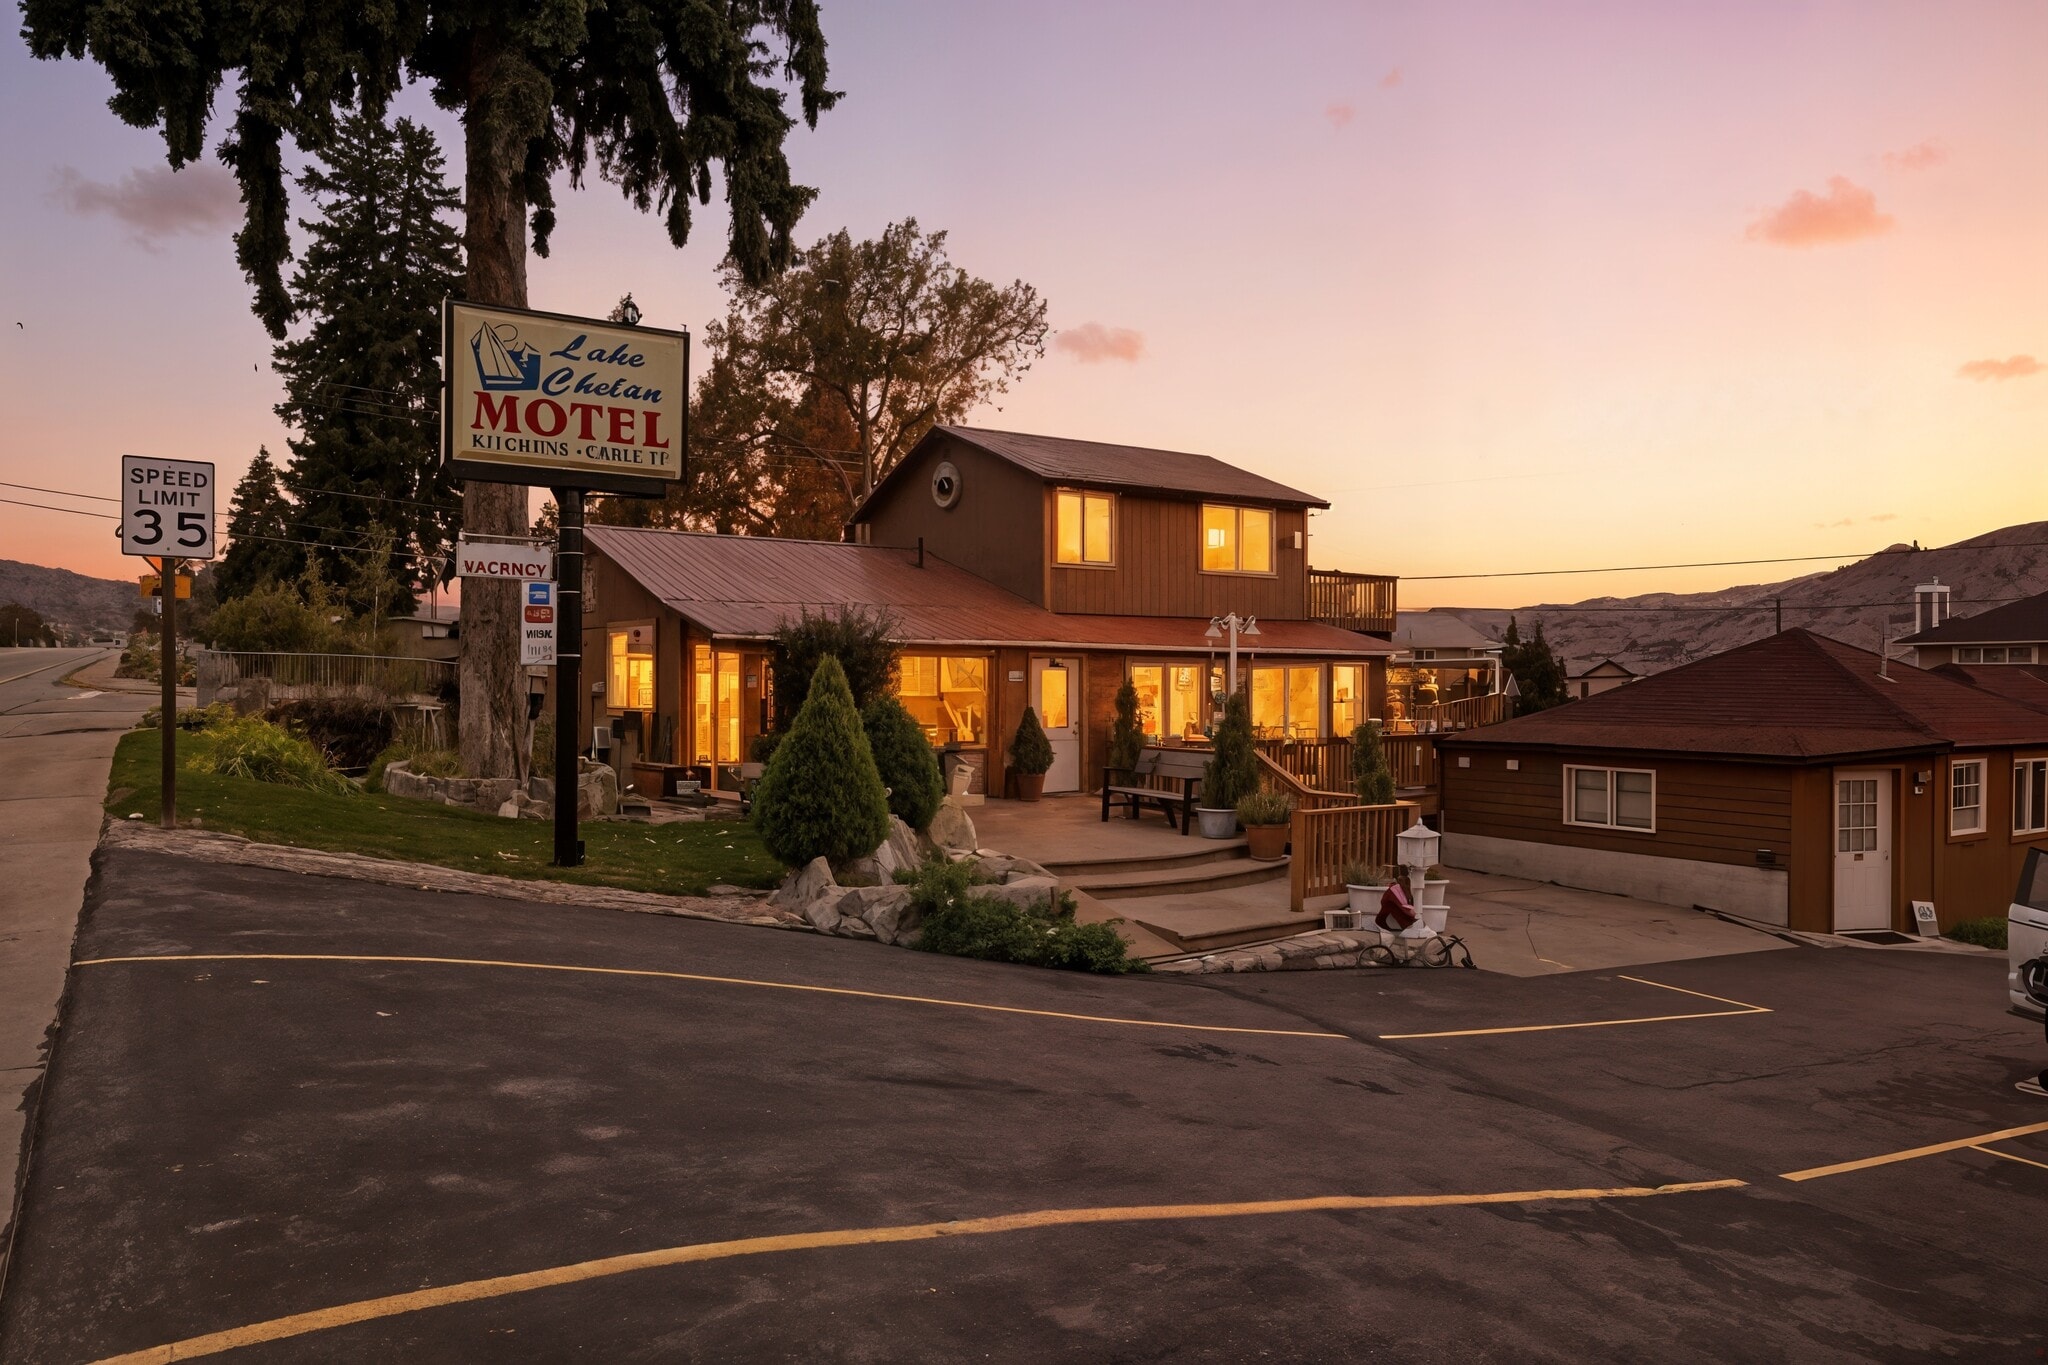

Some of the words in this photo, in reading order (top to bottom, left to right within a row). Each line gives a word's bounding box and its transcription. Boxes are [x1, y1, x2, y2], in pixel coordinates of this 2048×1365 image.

[549, 334, 646, 368] Lake
[470, 391, 670, 449] MOTEL
[130, 467, 208, 488] SPEED
[138, 489, 201, 507] LIMIT
[131, 509, 208, 548] 35
